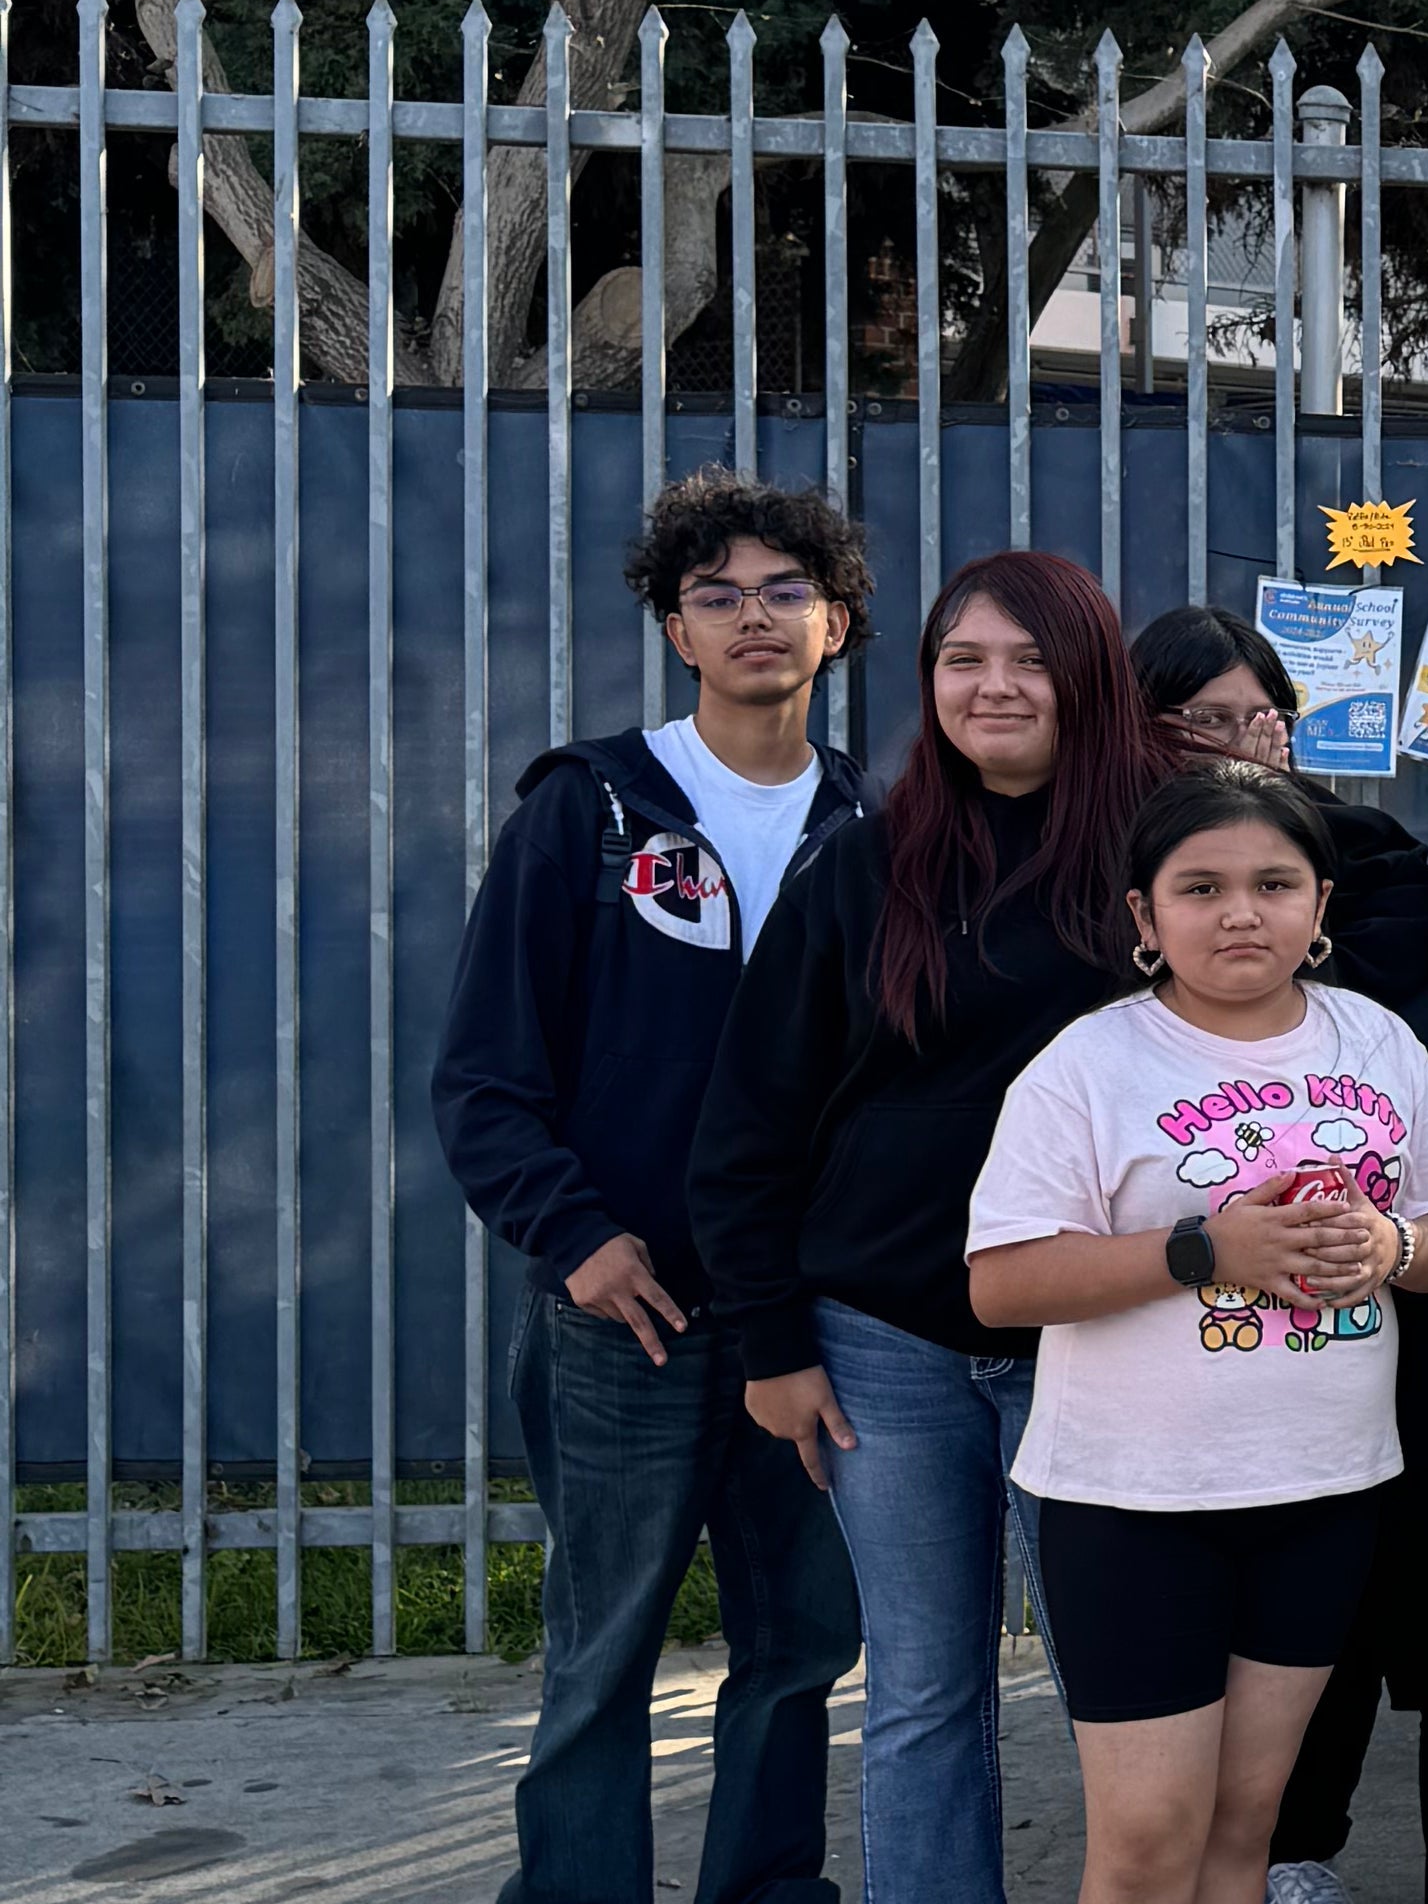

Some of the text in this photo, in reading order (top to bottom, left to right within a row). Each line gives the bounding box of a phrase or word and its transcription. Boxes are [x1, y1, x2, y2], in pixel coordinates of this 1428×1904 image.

[1356, 601, 1396, 614] School
[1269, 609, 1395, 629] Community Survey
[1157, 1080, 1294, 1146] Hello
